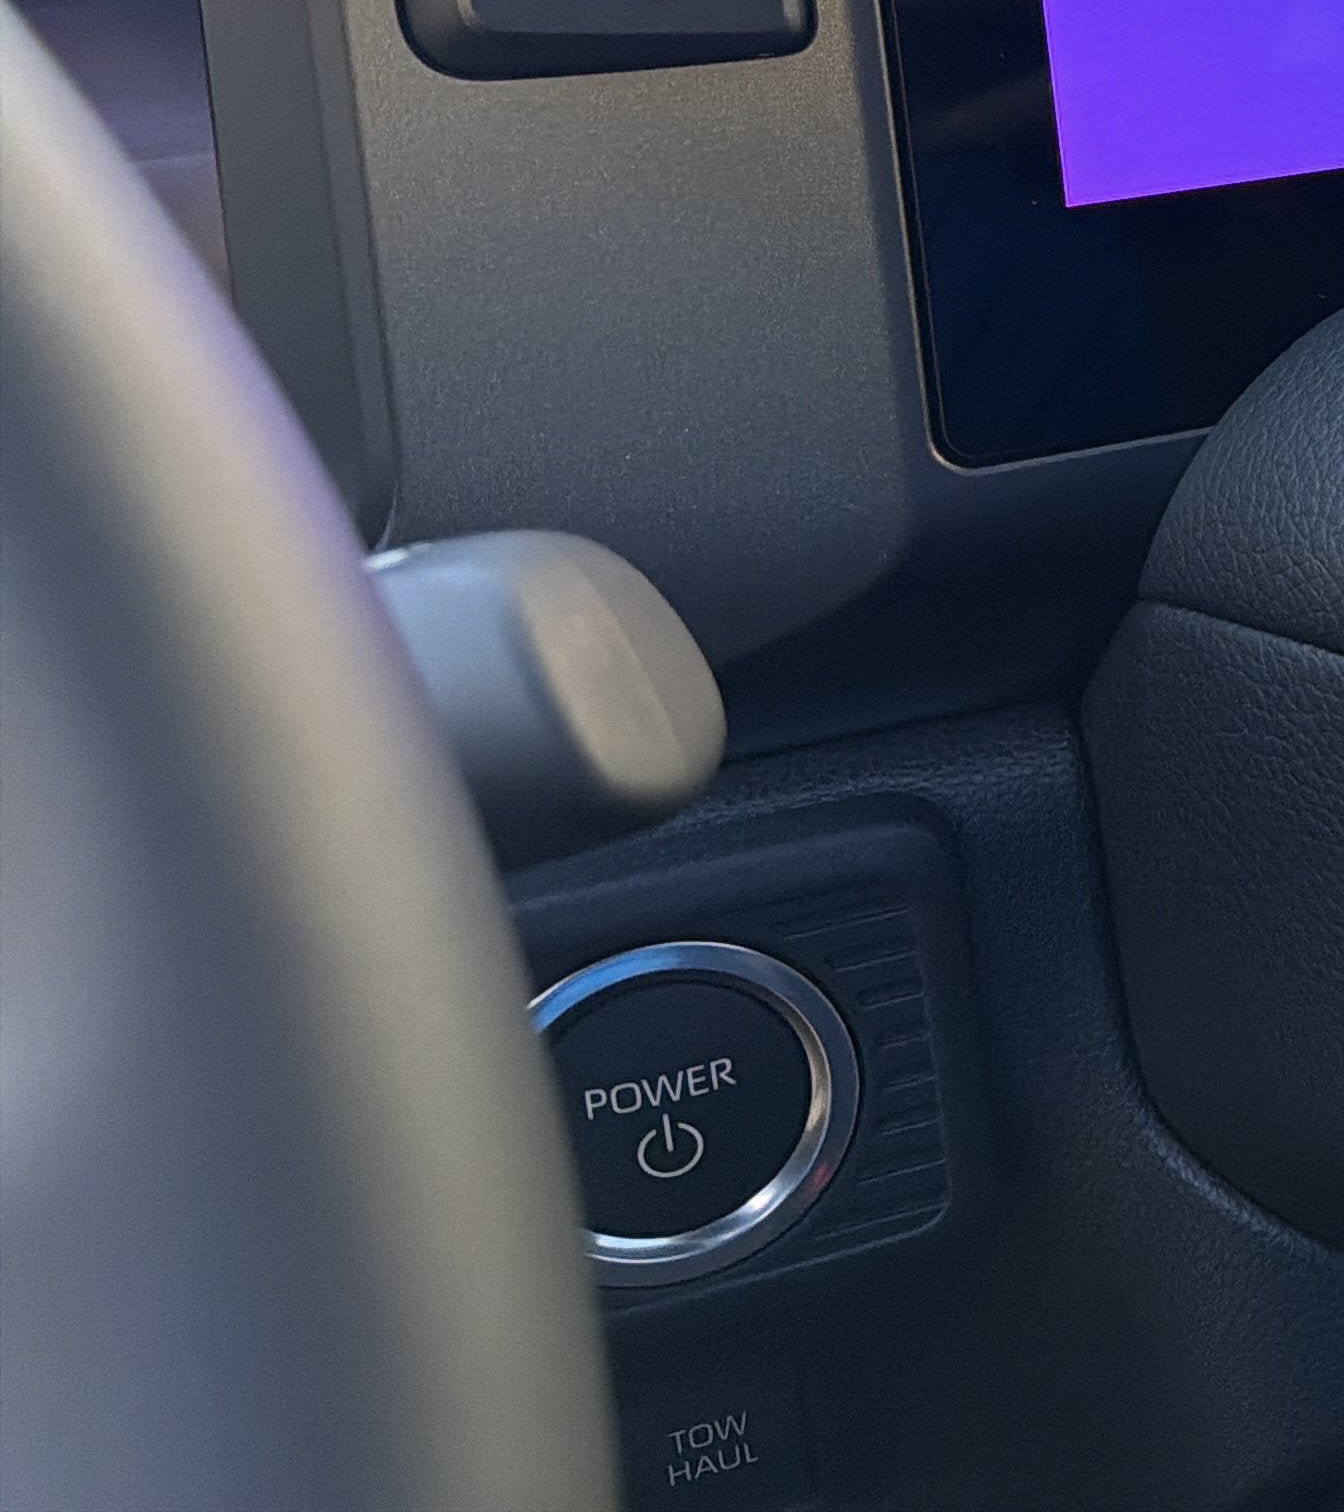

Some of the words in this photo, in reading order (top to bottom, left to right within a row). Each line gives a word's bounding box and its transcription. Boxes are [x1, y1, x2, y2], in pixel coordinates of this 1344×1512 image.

[584, 1057, 738, 1121] POWER
[668, 1411, 748, 1455] TOW
[667, 1443, 759, 1488] HAUL
